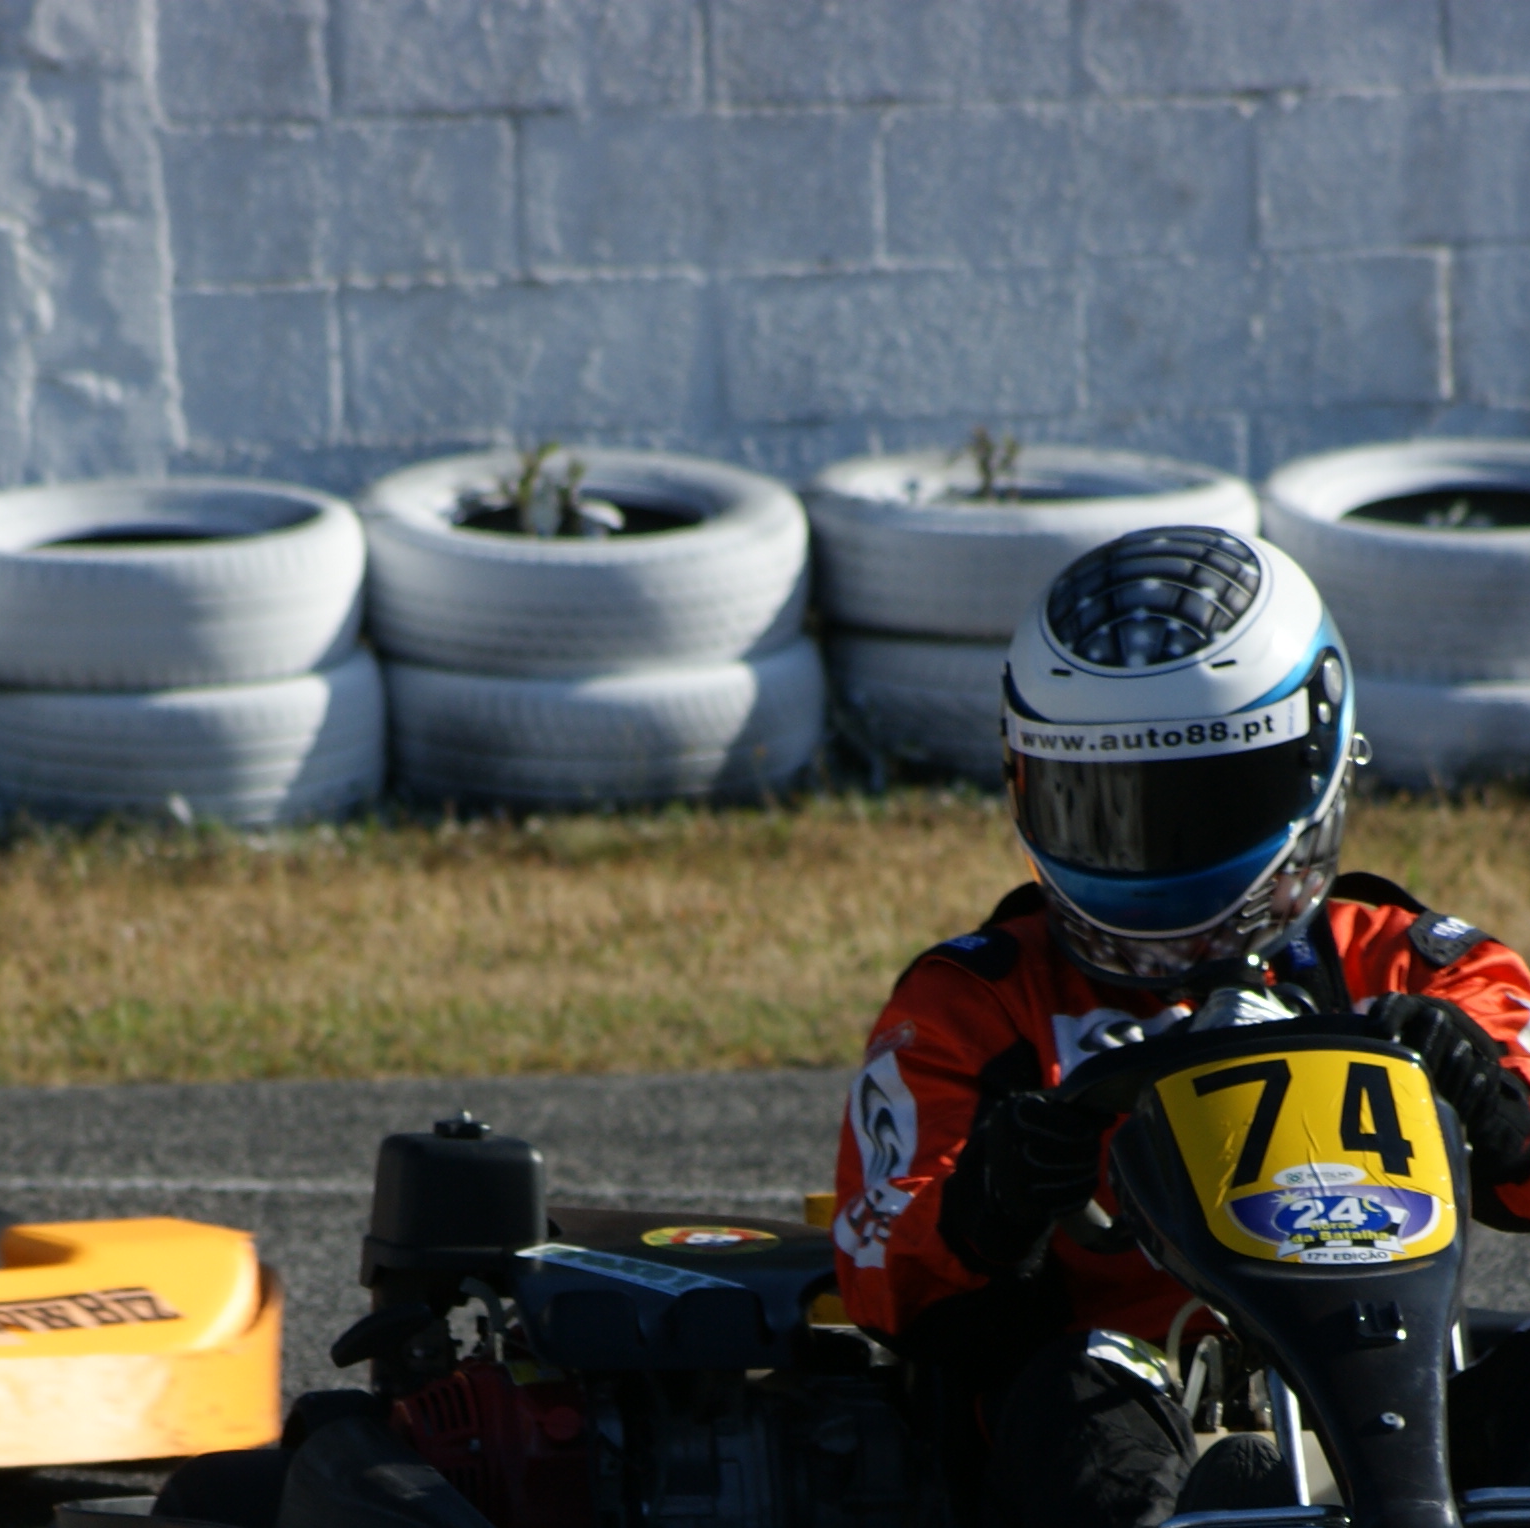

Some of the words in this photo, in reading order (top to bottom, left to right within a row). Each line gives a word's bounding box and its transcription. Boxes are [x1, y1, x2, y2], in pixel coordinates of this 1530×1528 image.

[1020, 714, 1276, 753] www.auto88.pt
[1191, 1058, 1416, 1190] 74
[1289, 1195, 1370, 1229] 24
[1290, 1232, 1316, 1244] da
[1318, 1229, 1391, 1242] Batalha
[1332, 1249, 1390, 1263] EDIÇÃO
